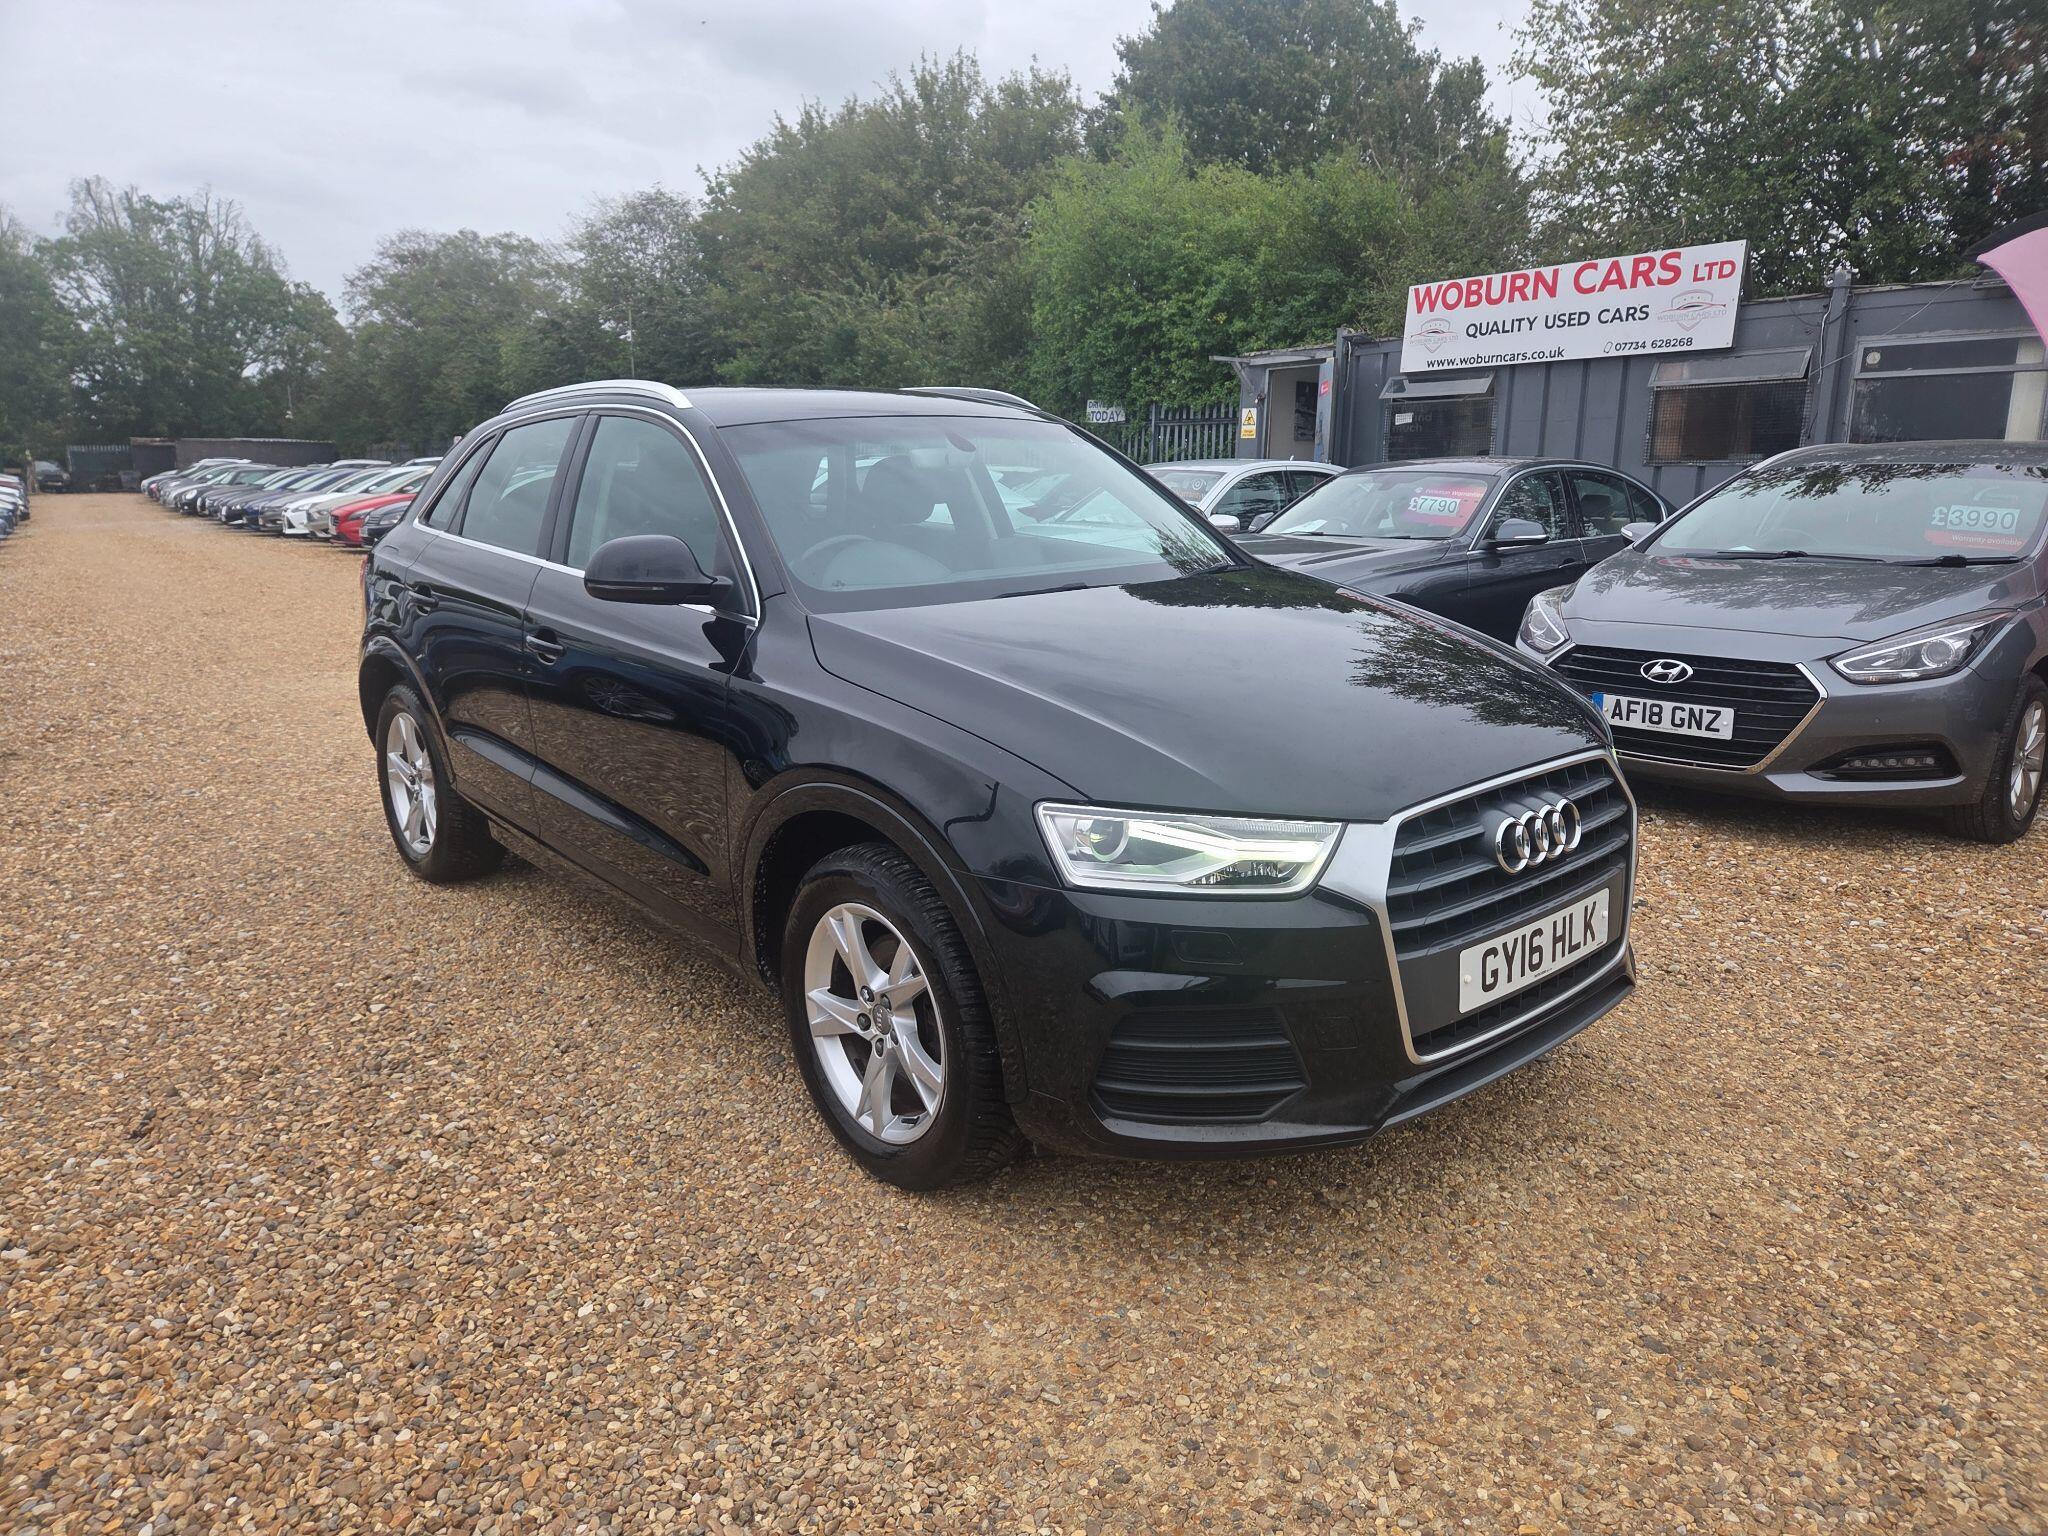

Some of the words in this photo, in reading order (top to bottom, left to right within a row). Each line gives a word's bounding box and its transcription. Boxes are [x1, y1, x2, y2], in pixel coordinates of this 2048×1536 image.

[1414, 267, 1560, 314] WOBURN
[1573, 251, 1682, 295] CARS
[1692, 259, 1737, 283] LTD
[1465, 315, 1538, 339] QUALITY
[1544, 310, 1591, 330] USED
[1597, 304, 1650, 324] CARS
[1614, 340, 1647, 352] 07734
[1651, 337, 1693, 349] 628268
[1426, 346, 1565, 368] www.woburncars.co.uk
[1090, 410, 1121, 421] TODAY
[1408, 496, 1458, 513] £7790
[1930, 506, 2016, 530] £3990
[1952, 534, 1985, 544] Warranty
[1610, 698, 1663, 726] AF18
[1670, 705, 1722, 733] GNZ
[1481, 927, 1544, 993] GY16
[1551, 901, 1597, 964] HLK
